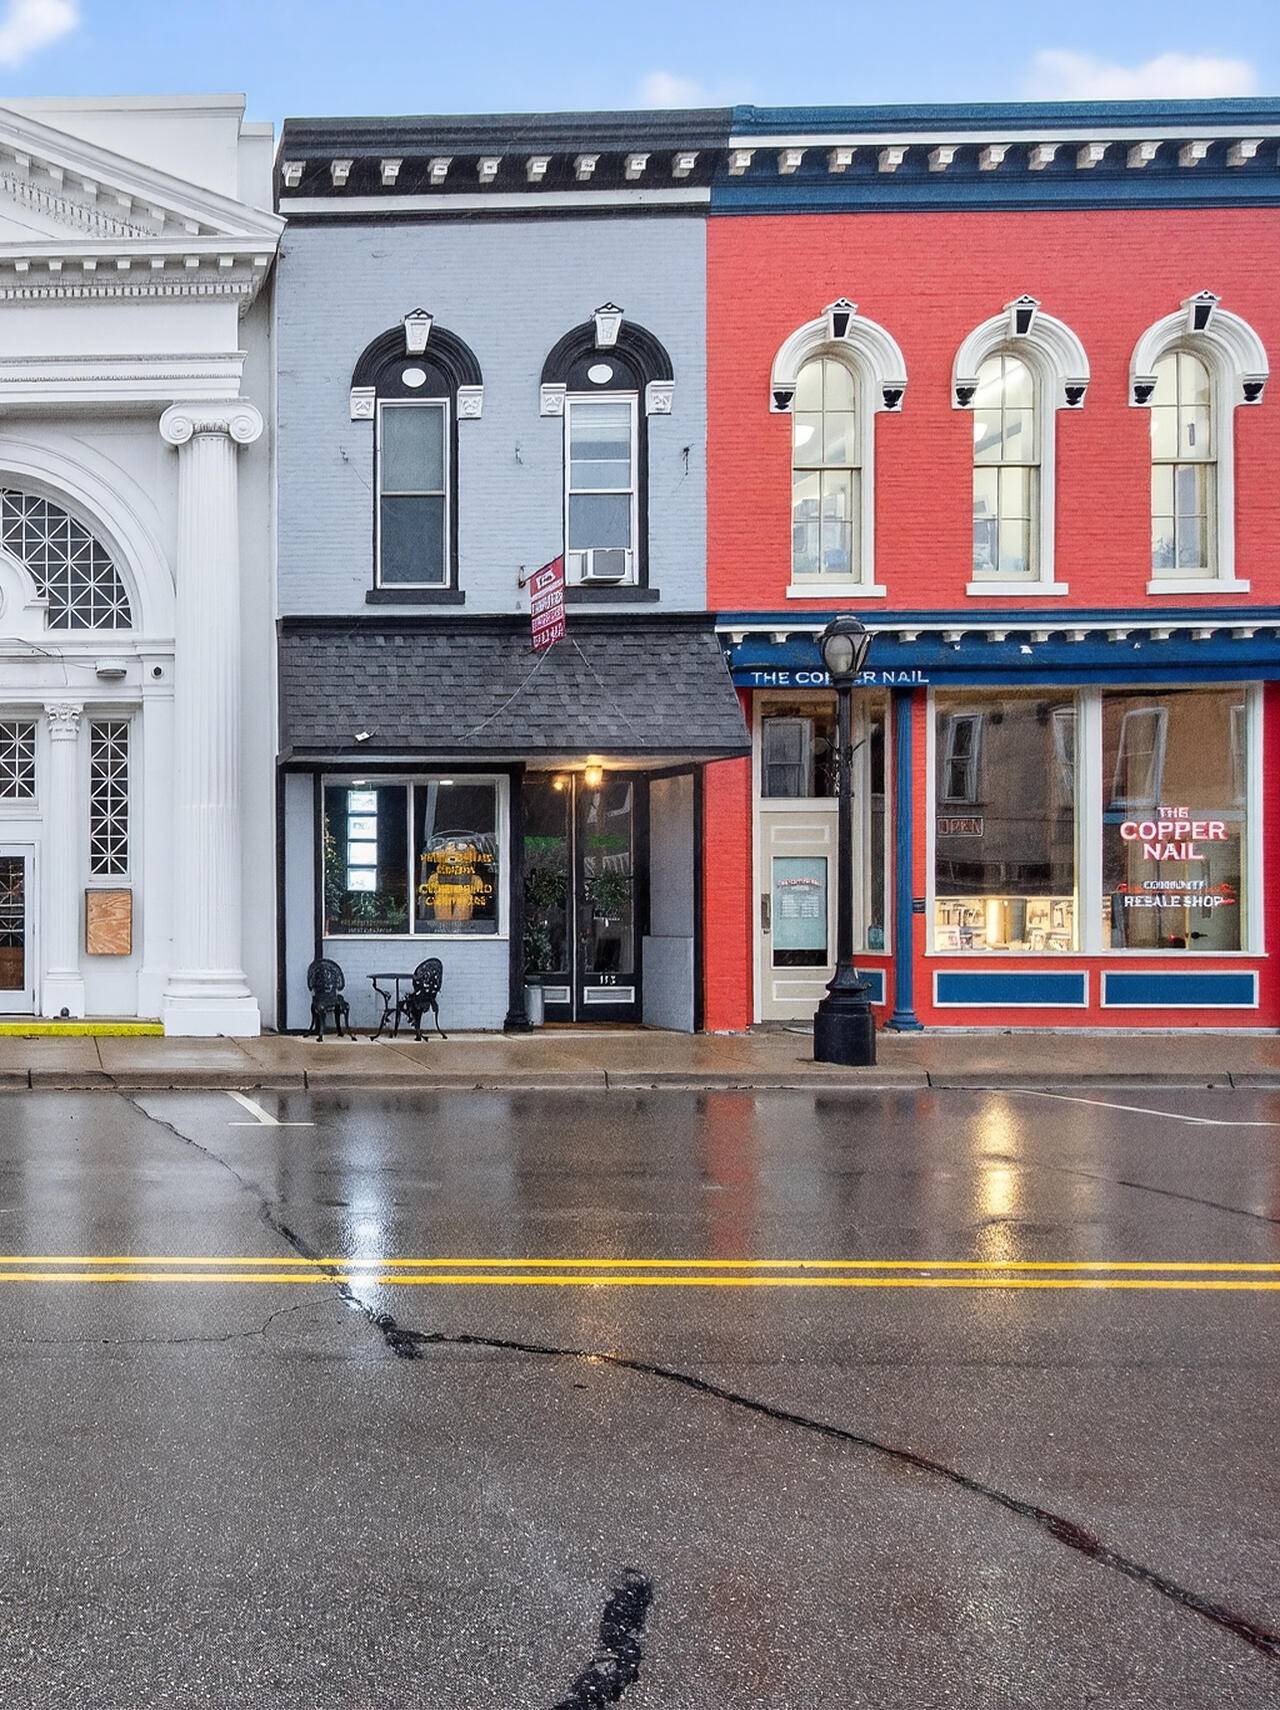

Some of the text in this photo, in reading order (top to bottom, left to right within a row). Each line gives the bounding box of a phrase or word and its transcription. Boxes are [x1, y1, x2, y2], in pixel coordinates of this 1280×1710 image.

[751, 670, 930, 685] THE COR NAIL
[1157, 807, 1190, 818] THE
[1120, 821, 1228, 840] COPPER
[1143, 842, 1205, 860] NAIL
[1124, 895, 1224, 908] RESALE SHOP
